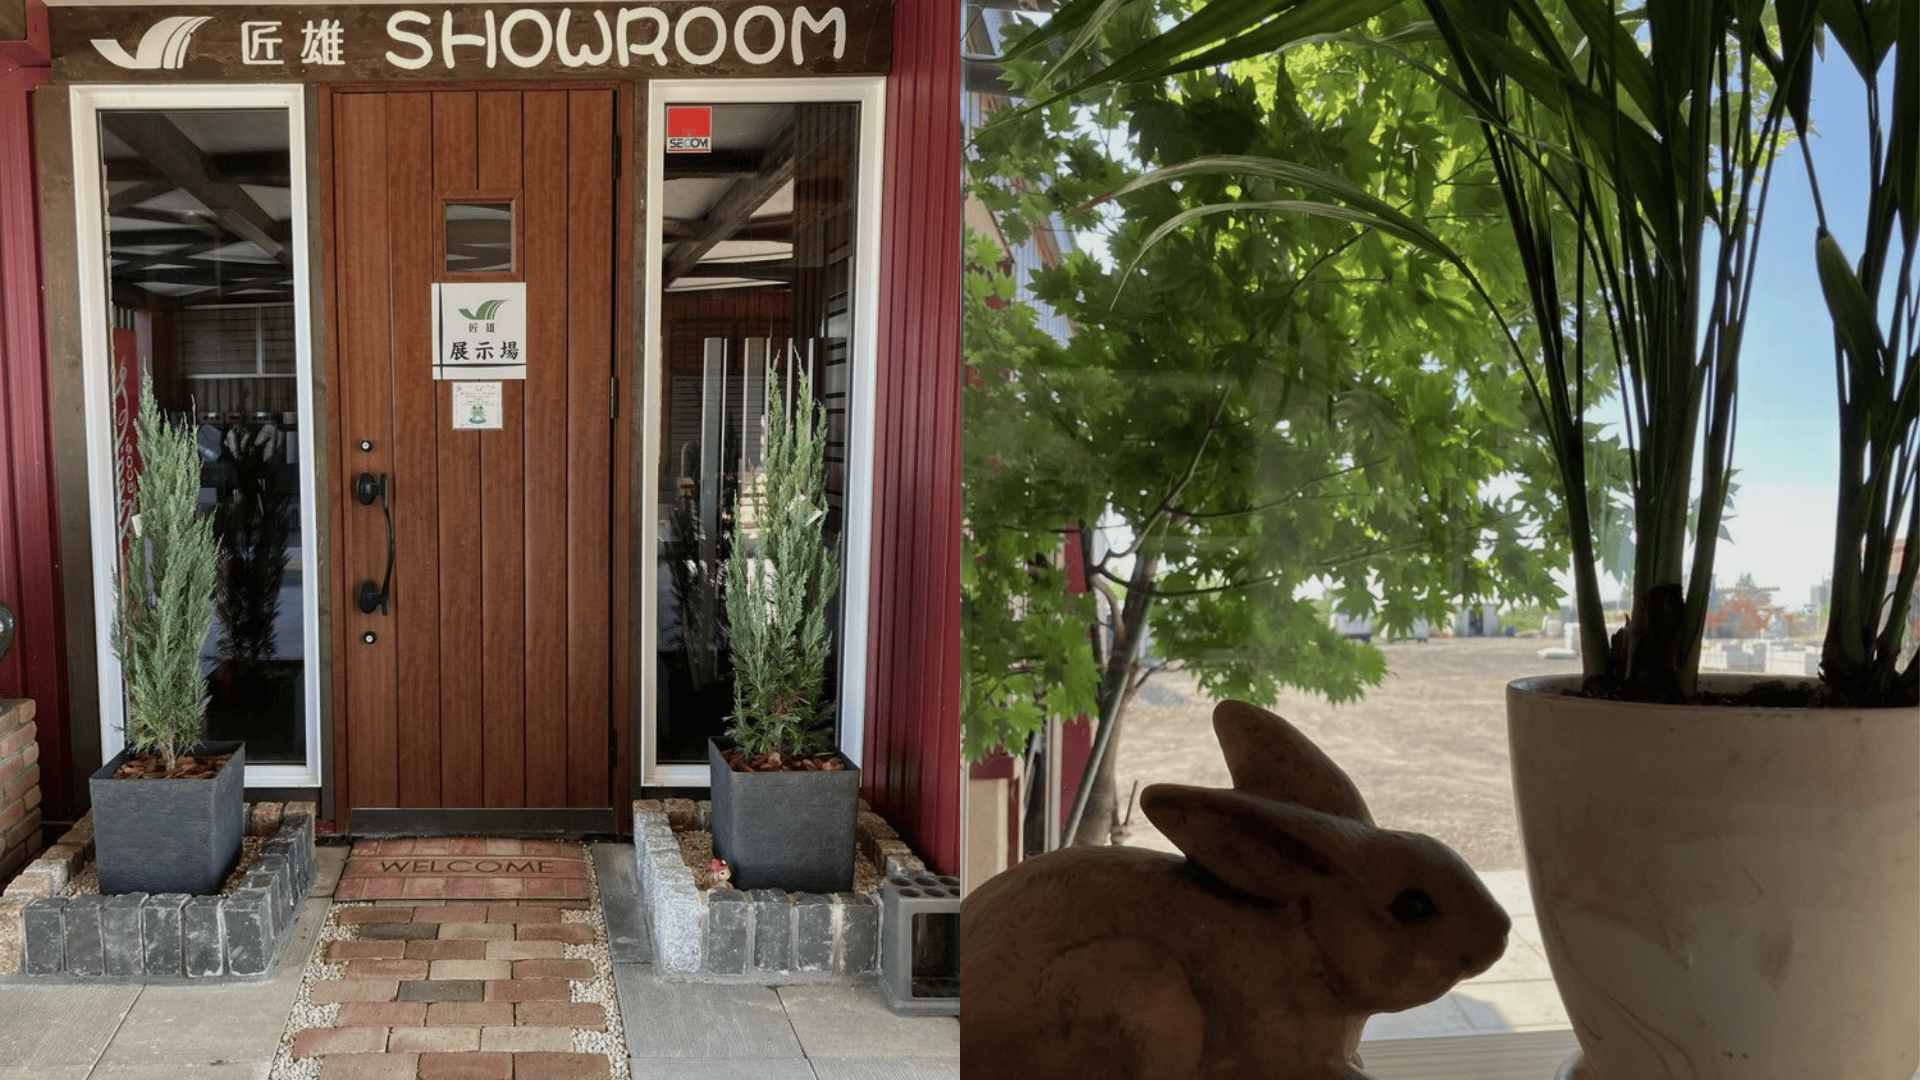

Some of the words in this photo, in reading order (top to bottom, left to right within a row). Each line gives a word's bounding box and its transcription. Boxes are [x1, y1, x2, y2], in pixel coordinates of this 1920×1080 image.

[241, 18, 345, 65] 匠雄
[385, 6, 846, 69] SHOWROOM
[669, 138, 709, 148] SECOM
[469, 322, 496, 333] 匠雄
[450, 341, 519, 360] 展示場
[381, 859, 555, 874] WELCOME
